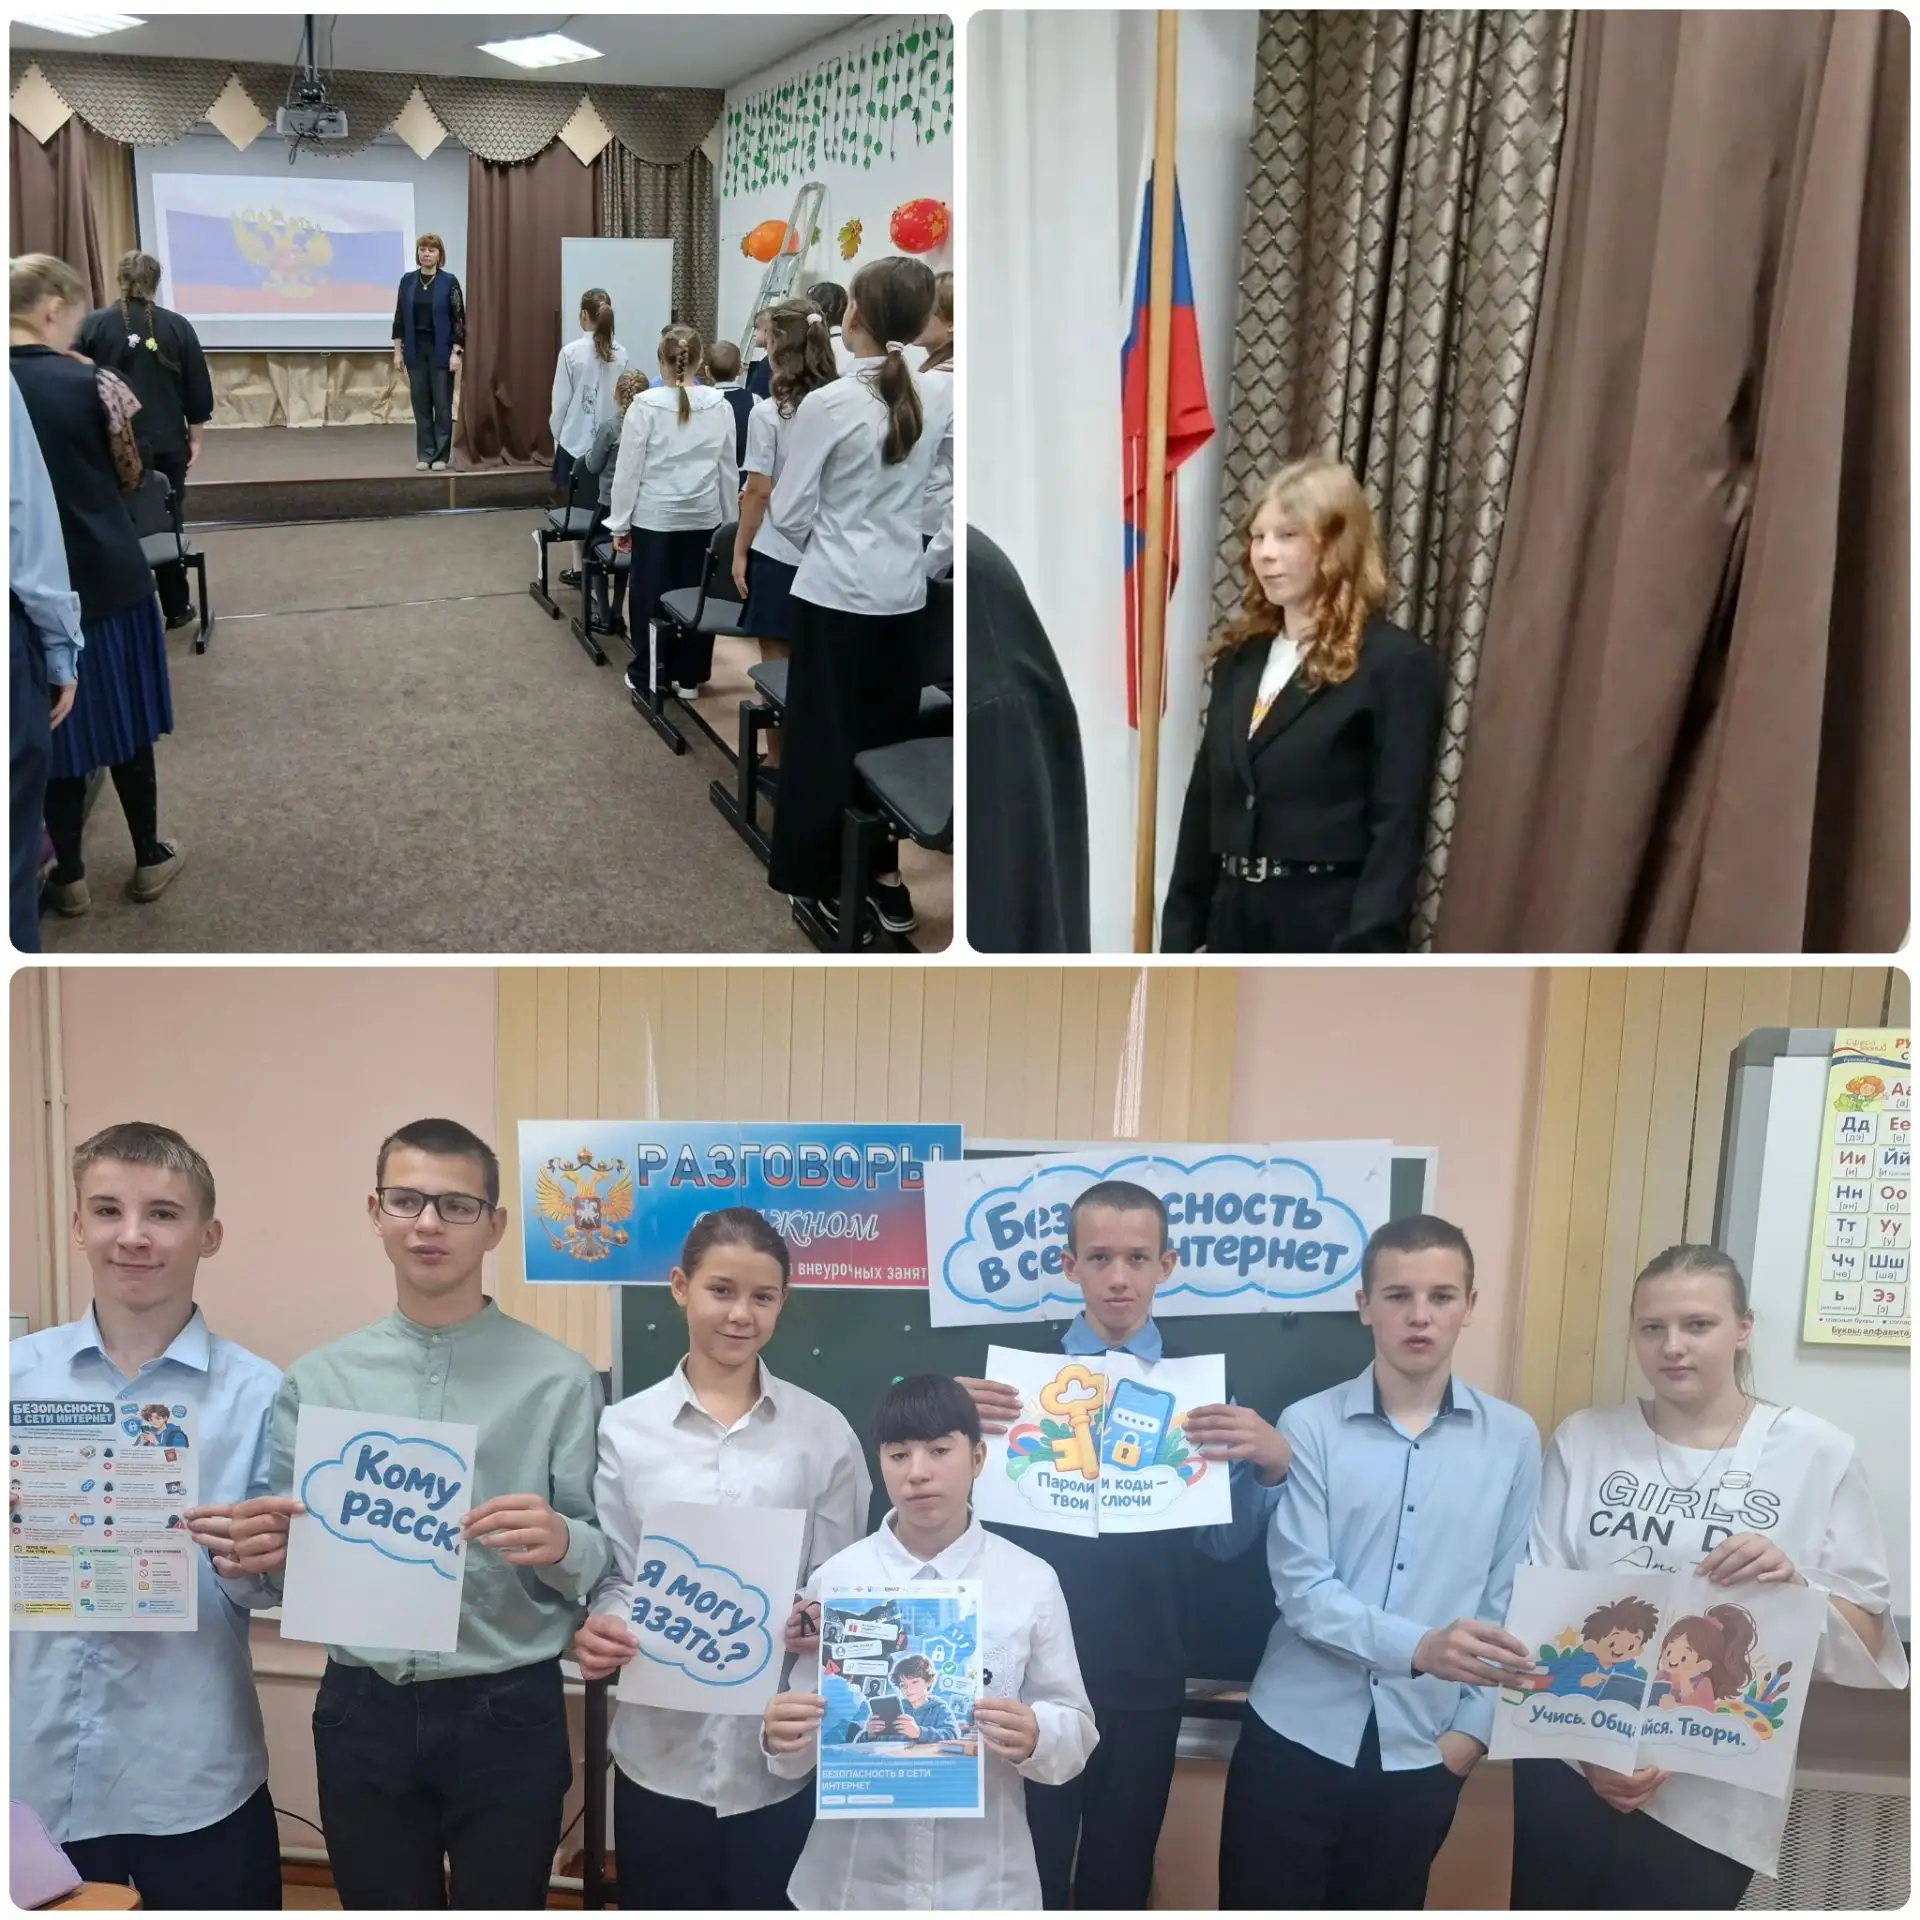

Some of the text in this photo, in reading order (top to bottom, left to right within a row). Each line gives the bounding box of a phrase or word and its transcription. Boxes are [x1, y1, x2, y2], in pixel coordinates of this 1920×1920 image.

[1841, 1116, 1911, 1133] Дд Ее
[1840, 1148, 1911, 1165] Ии Йй
[637, 1142, 943, 1191] РАЗГОВОРЫ
[1837, 1185, 1907, 1200] Нн Оо
[985, 1192, 1322, 1251] Безсность
[1837, 1218, 1902, 1236] Тт Уу
[978, 1235, 1349, 1293] в се нтернет
[1831, 1253, 1904, 1268] Чч Шш
[887, 1266, 928, 1281] занят
[1872, 1289, 1895, 1303] Ээ
[12, 1403, 110, 1414] БЕЗОПАСНОСТЬ
[13, 1413, 113, 1424] В СЕТИ ИНТЕРНЕТ
[355, 1444, 461, 1511] Кому
[1037, 1472, 1095, 1493] Пароли
[1101, 1478, 1110, 1489] и
[1115, 1479, 1153, 1491] коды
[1600, 1470, 1780, 1529] GIRLS
[339, 1490, 460, 1556] расск
[1589, 1510, 1675, 1546] CAN
[665, 1574, 756, 1637] могу
[1529, 1705, 1586, 1727] Учись.
[1678, 1717, 1746, 1746] Твори.
[822, 1769, 931, 1779] БЕЗОПАСНОСТЬ В СЕТИ
[822, 1781, 871, 1790] ИНТЕРНЕТ
